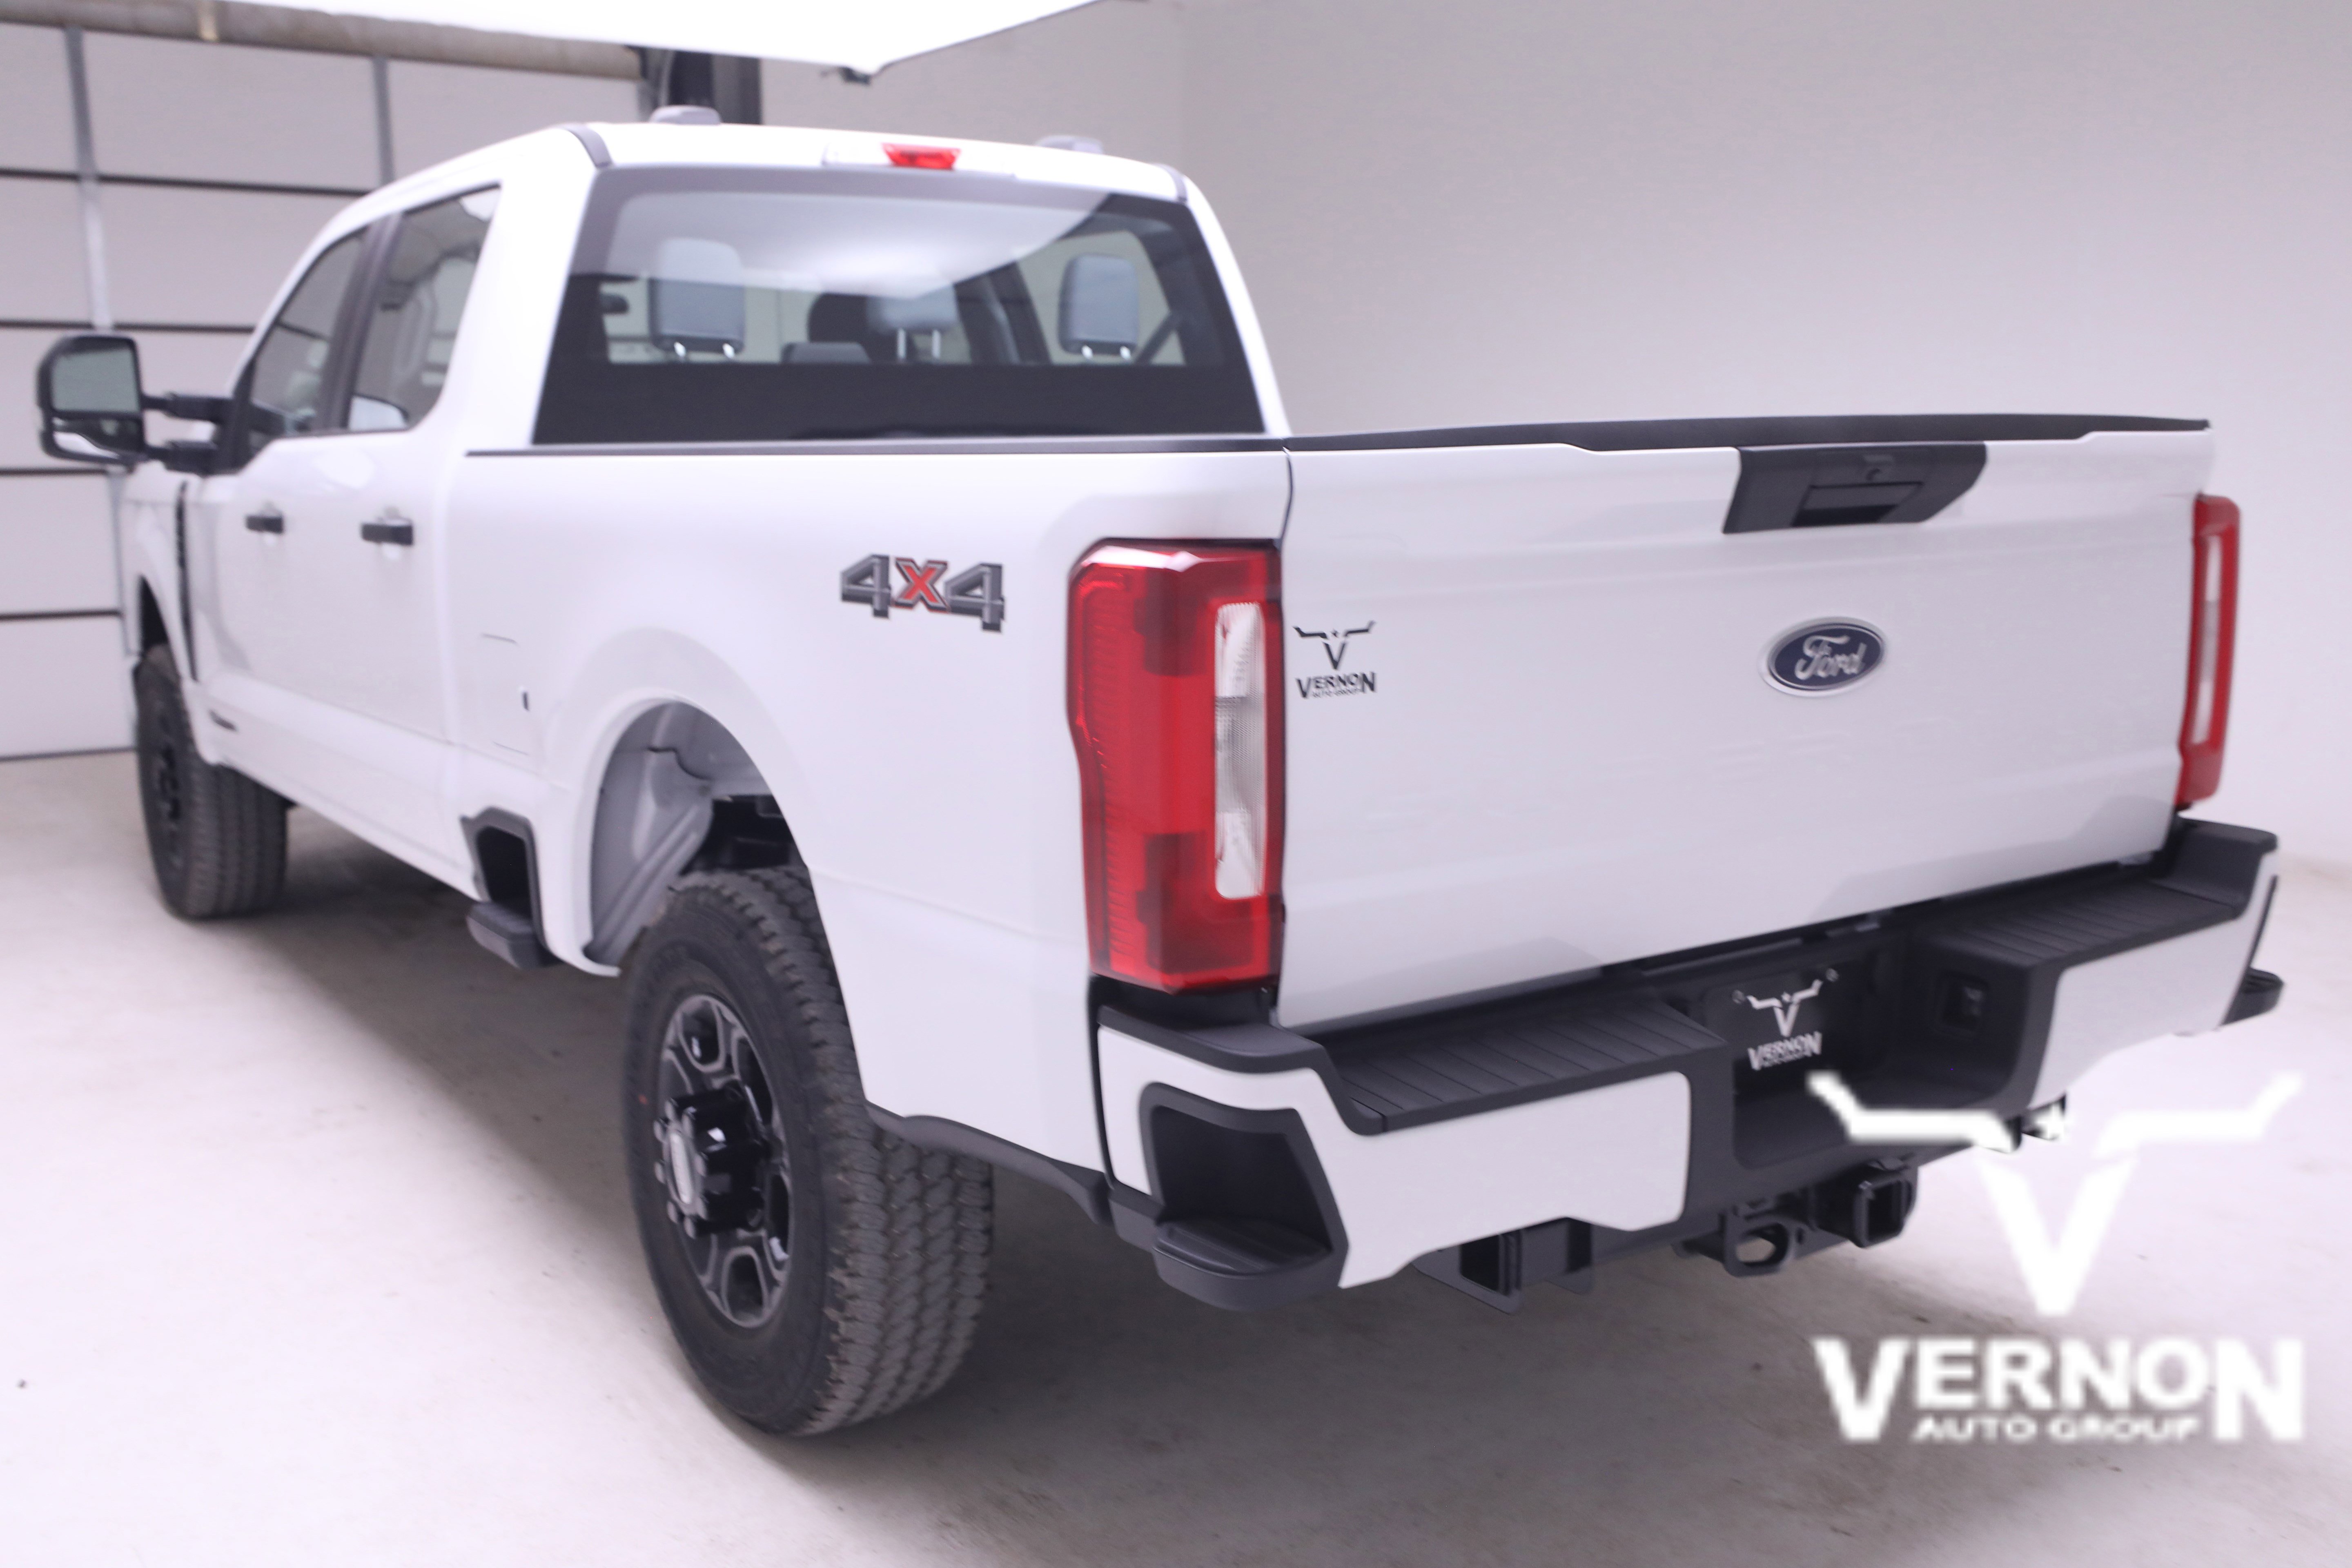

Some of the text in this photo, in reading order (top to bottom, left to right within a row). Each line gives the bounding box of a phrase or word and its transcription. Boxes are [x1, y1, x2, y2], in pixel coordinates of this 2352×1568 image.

[1795, 635, 1867, 680] Ford
[1295, 671, 1376, 699] VERNON
[1747, 1031, 1822, 1071] VERNON
